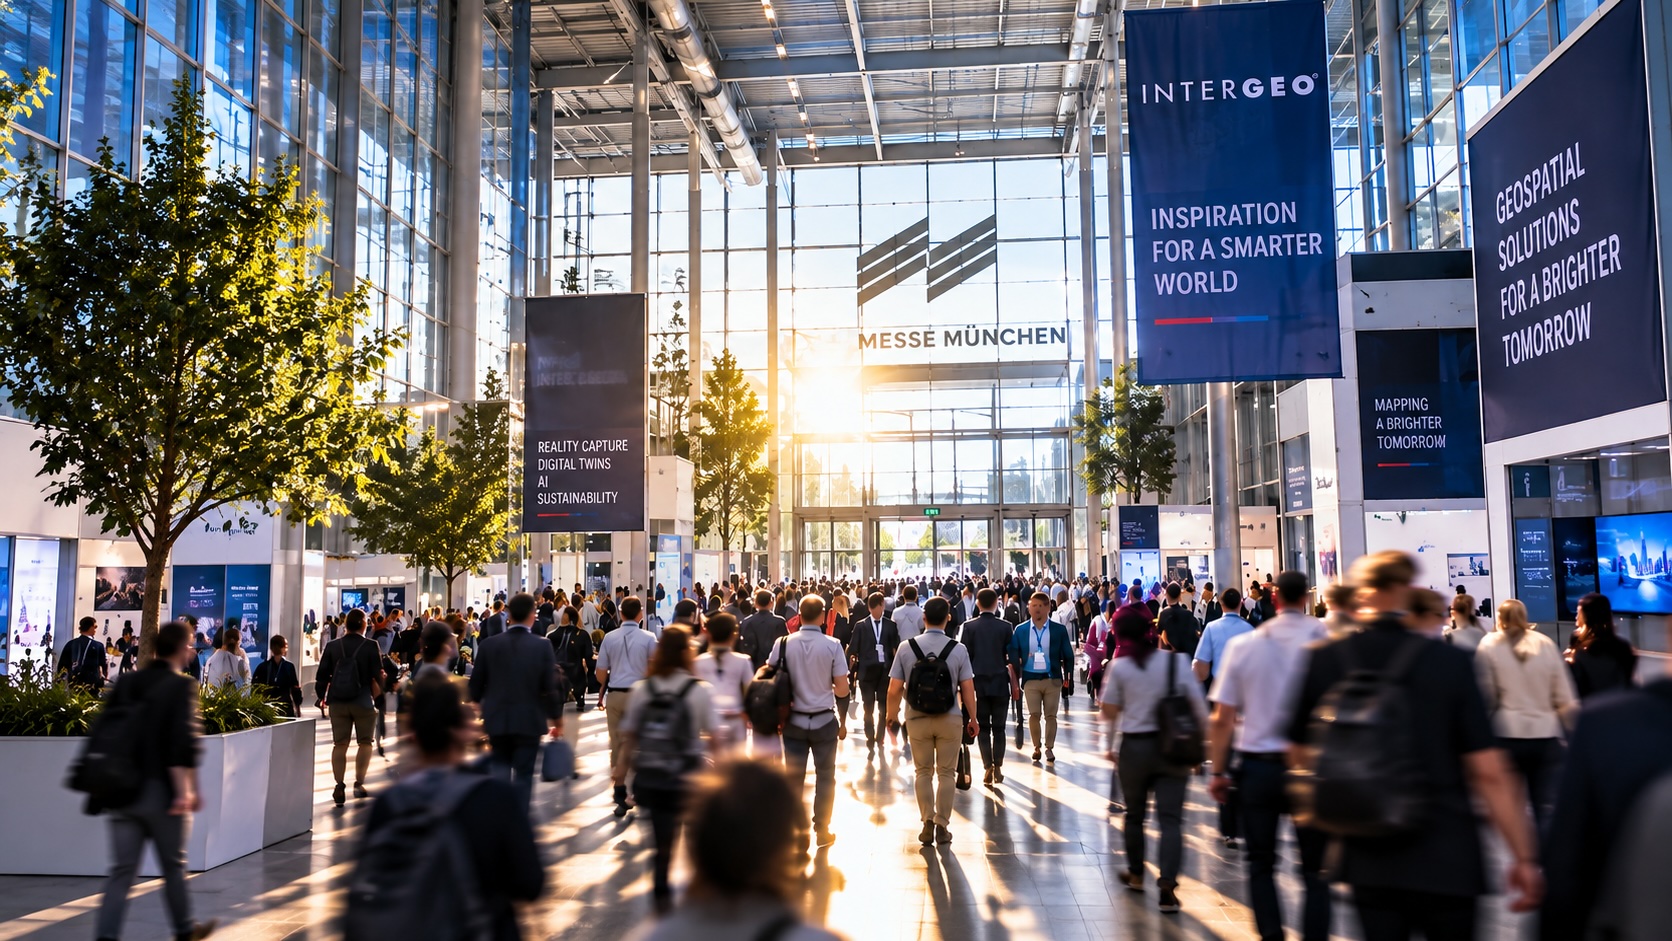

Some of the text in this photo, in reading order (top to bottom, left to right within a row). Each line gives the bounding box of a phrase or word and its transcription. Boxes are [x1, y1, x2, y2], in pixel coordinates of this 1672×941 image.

[1496, 142, 1585, 224] GEOSPATIAL
[1151, 201, 1297, 230] INSPIRATION
[1152, 232, 1323, 263] FOR A SMARTER
[1498, 198, 1581, 272] SOLUTIONS
[1153, 270, 1238, 296] WORLD
[1500, 233, 1622, 320] FOR A BRIGHTER
[858, 324, 1066, 349] MESSE MÜNCHEN
[1502, 301, 1591, 367] TOMORROW
[1374, 397, 1429, 412] MAPPING
[1375, 416, 1442, 430] A BRIGHTER
[538, 439, 628, 454] REALITY CAPTURE
[1376, 434, 1446, 449] TOMORROW
[538, 457, 611, 471] DIGITAL TWINS
[537, 475, 549, 488] AI
[537, 491, 619, 505] SUSTAINABILITY
